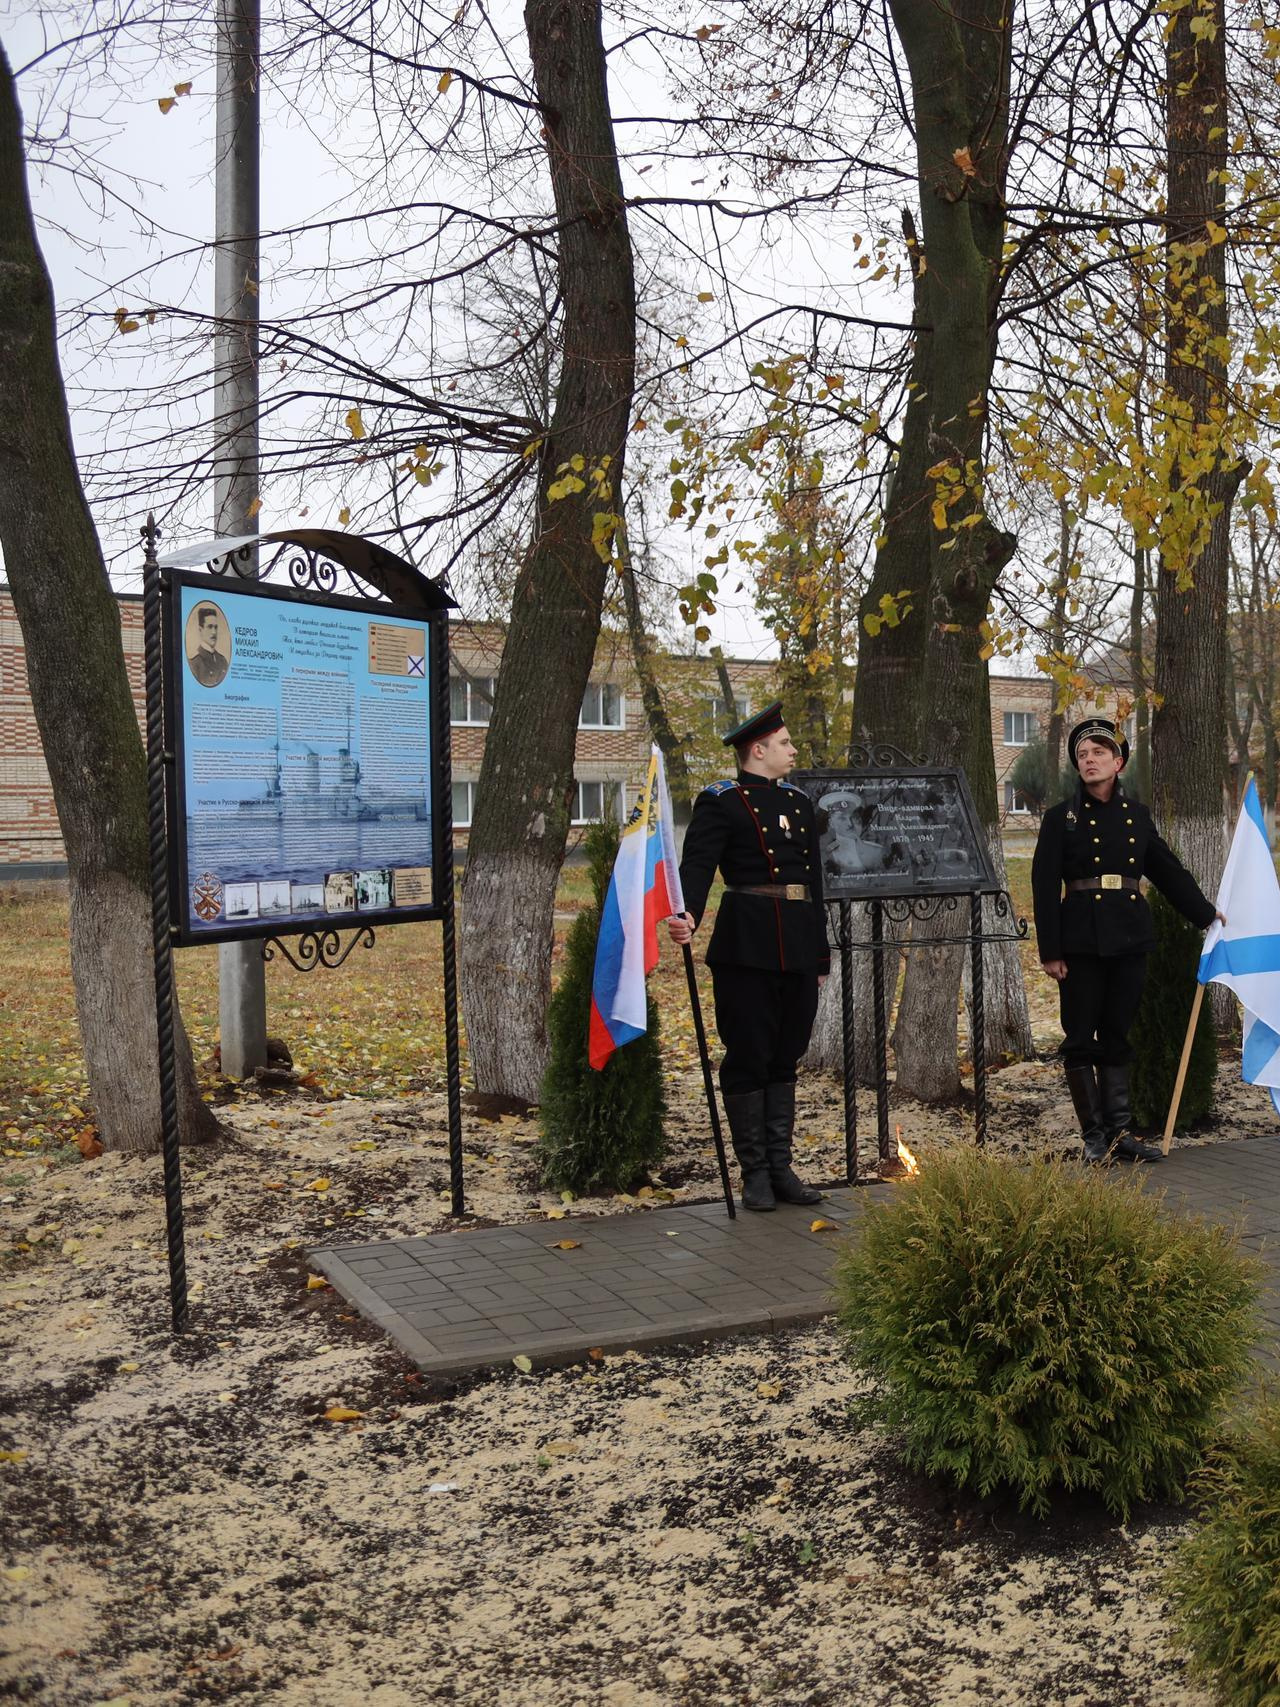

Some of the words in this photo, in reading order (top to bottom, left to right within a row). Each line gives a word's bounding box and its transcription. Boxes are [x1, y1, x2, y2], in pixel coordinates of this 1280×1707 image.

[235, 626, 258, 637] КЕДРОВ
[235, 637, 259, 648] МИХАИЛ
[235, 648, 284, 661] АЛЕКСАНДРОВИЧ
[224, 693, 250, 702] Биография
[877, 803, 934, 813] Вице-адмирал
[870, 824, 897, 832] Михаил
[900, 823, 950, 832] Александрович
[918, 834, 934, 843] 1945
